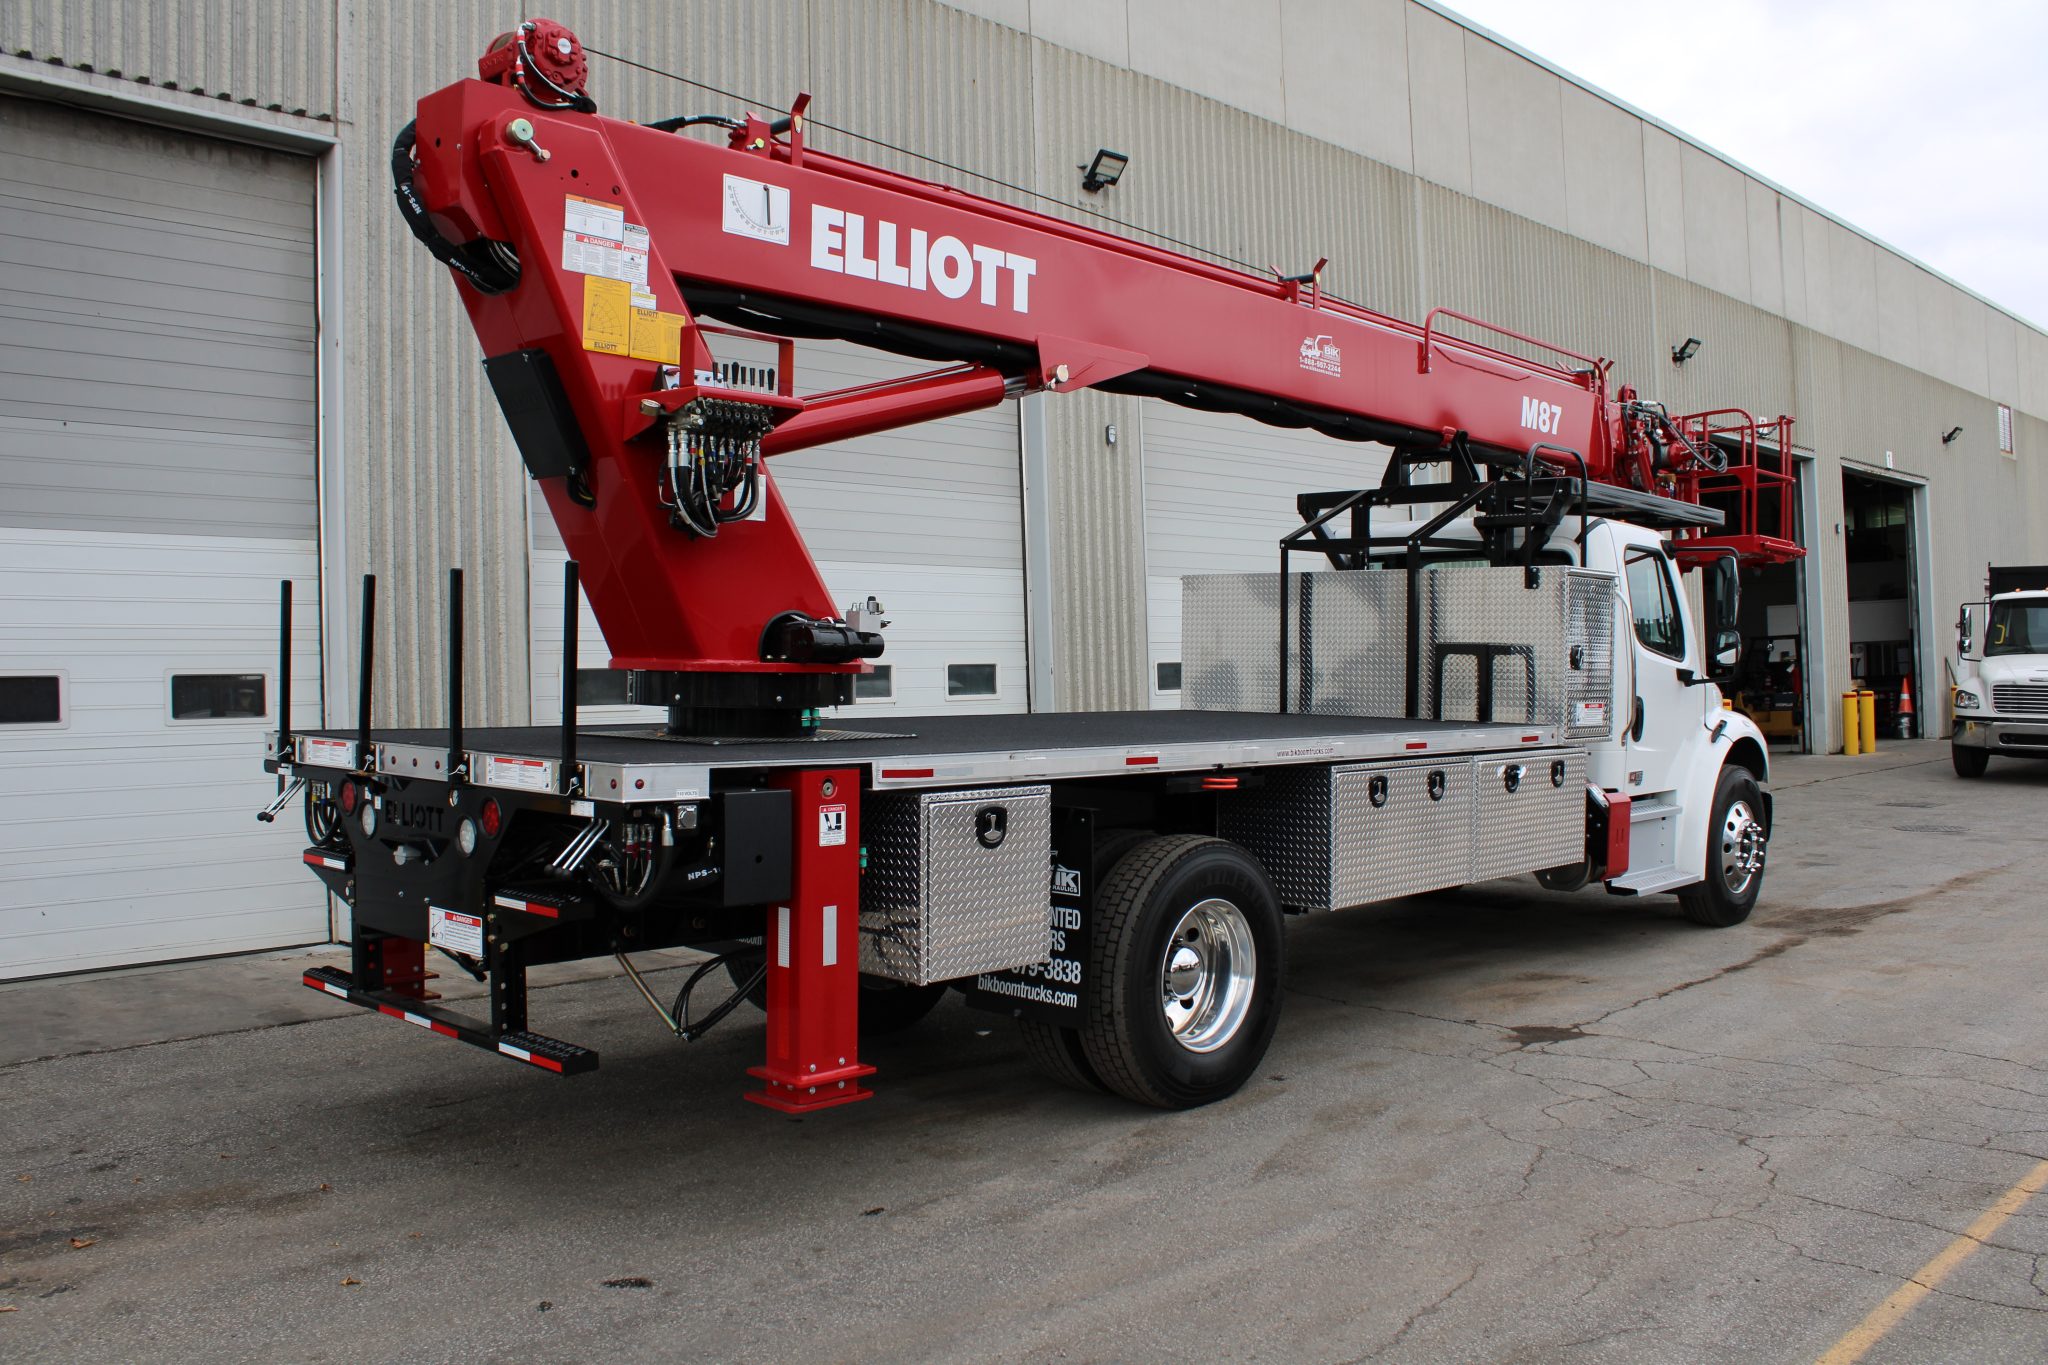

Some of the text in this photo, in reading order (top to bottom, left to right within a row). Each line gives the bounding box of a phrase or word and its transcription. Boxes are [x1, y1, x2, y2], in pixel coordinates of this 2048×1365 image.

[589, 237, 616, 249] DANGER
[810, 203, 1037, 314] ELLIOTT
[636, 308, 659, 319] ELLIOTT
[593, 341, 618, 352] ELLIOTT
[1324, 345, 1340, 359] BIK
[1520, 395, 1562, 435] M87
[385, 800, 443, 832] ELLIOTT
[688, 867, 721, 880] NPS-1
[1051, 871, 1077, 888] IK
[1052, 885, 1078, 893] RAULICS
[1050, 906, 1081, 930] NTED
[1050, 929, 1066, 952] RS
[977, 974, 1078, 1008] bikboomtrucks.com
